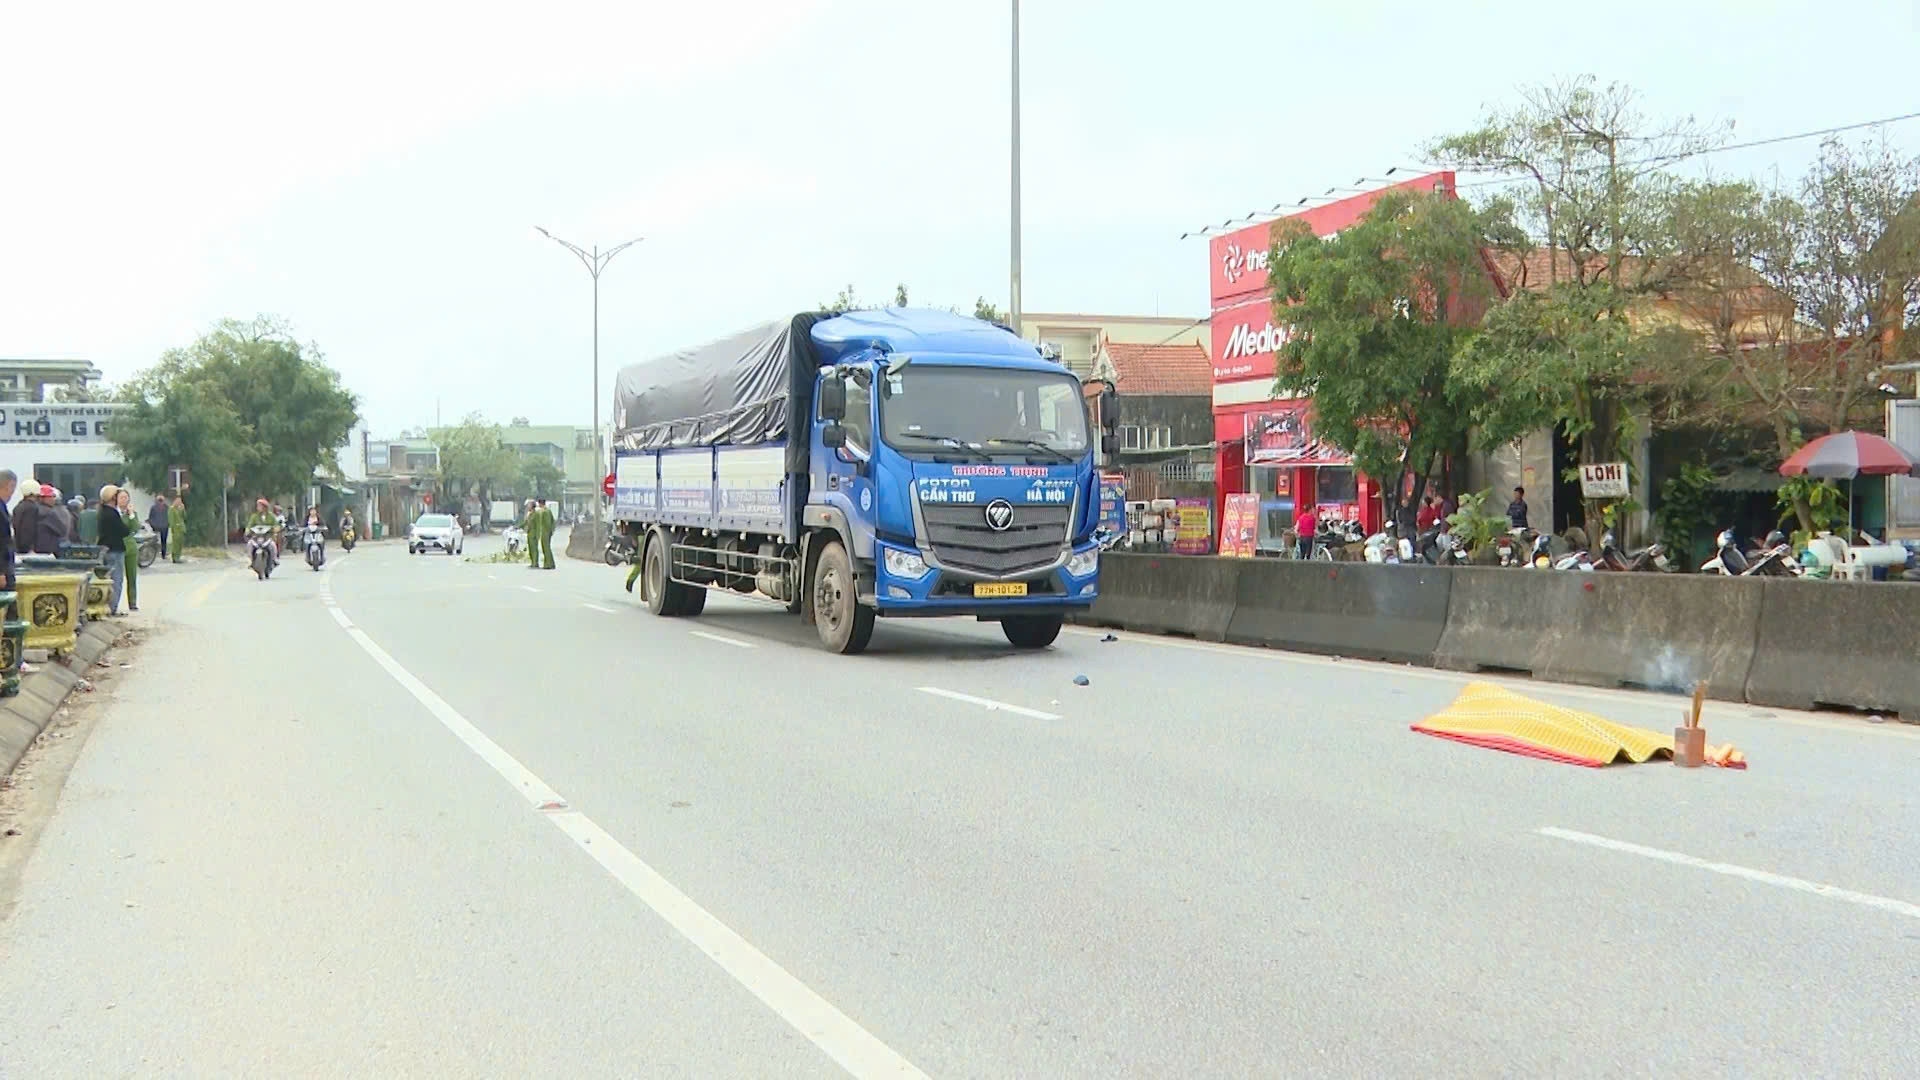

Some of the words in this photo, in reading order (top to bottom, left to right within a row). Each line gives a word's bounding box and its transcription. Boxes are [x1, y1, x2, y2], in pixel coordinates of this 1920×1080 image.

[1246, 249, 1269, 272] the
[1223, 321, 1293, 360] Media
[951, 490, 976, 502] THƠ
[1026, 488, 1044, 501] HÀ
[1046, 488, 1066, 504] NỘI
